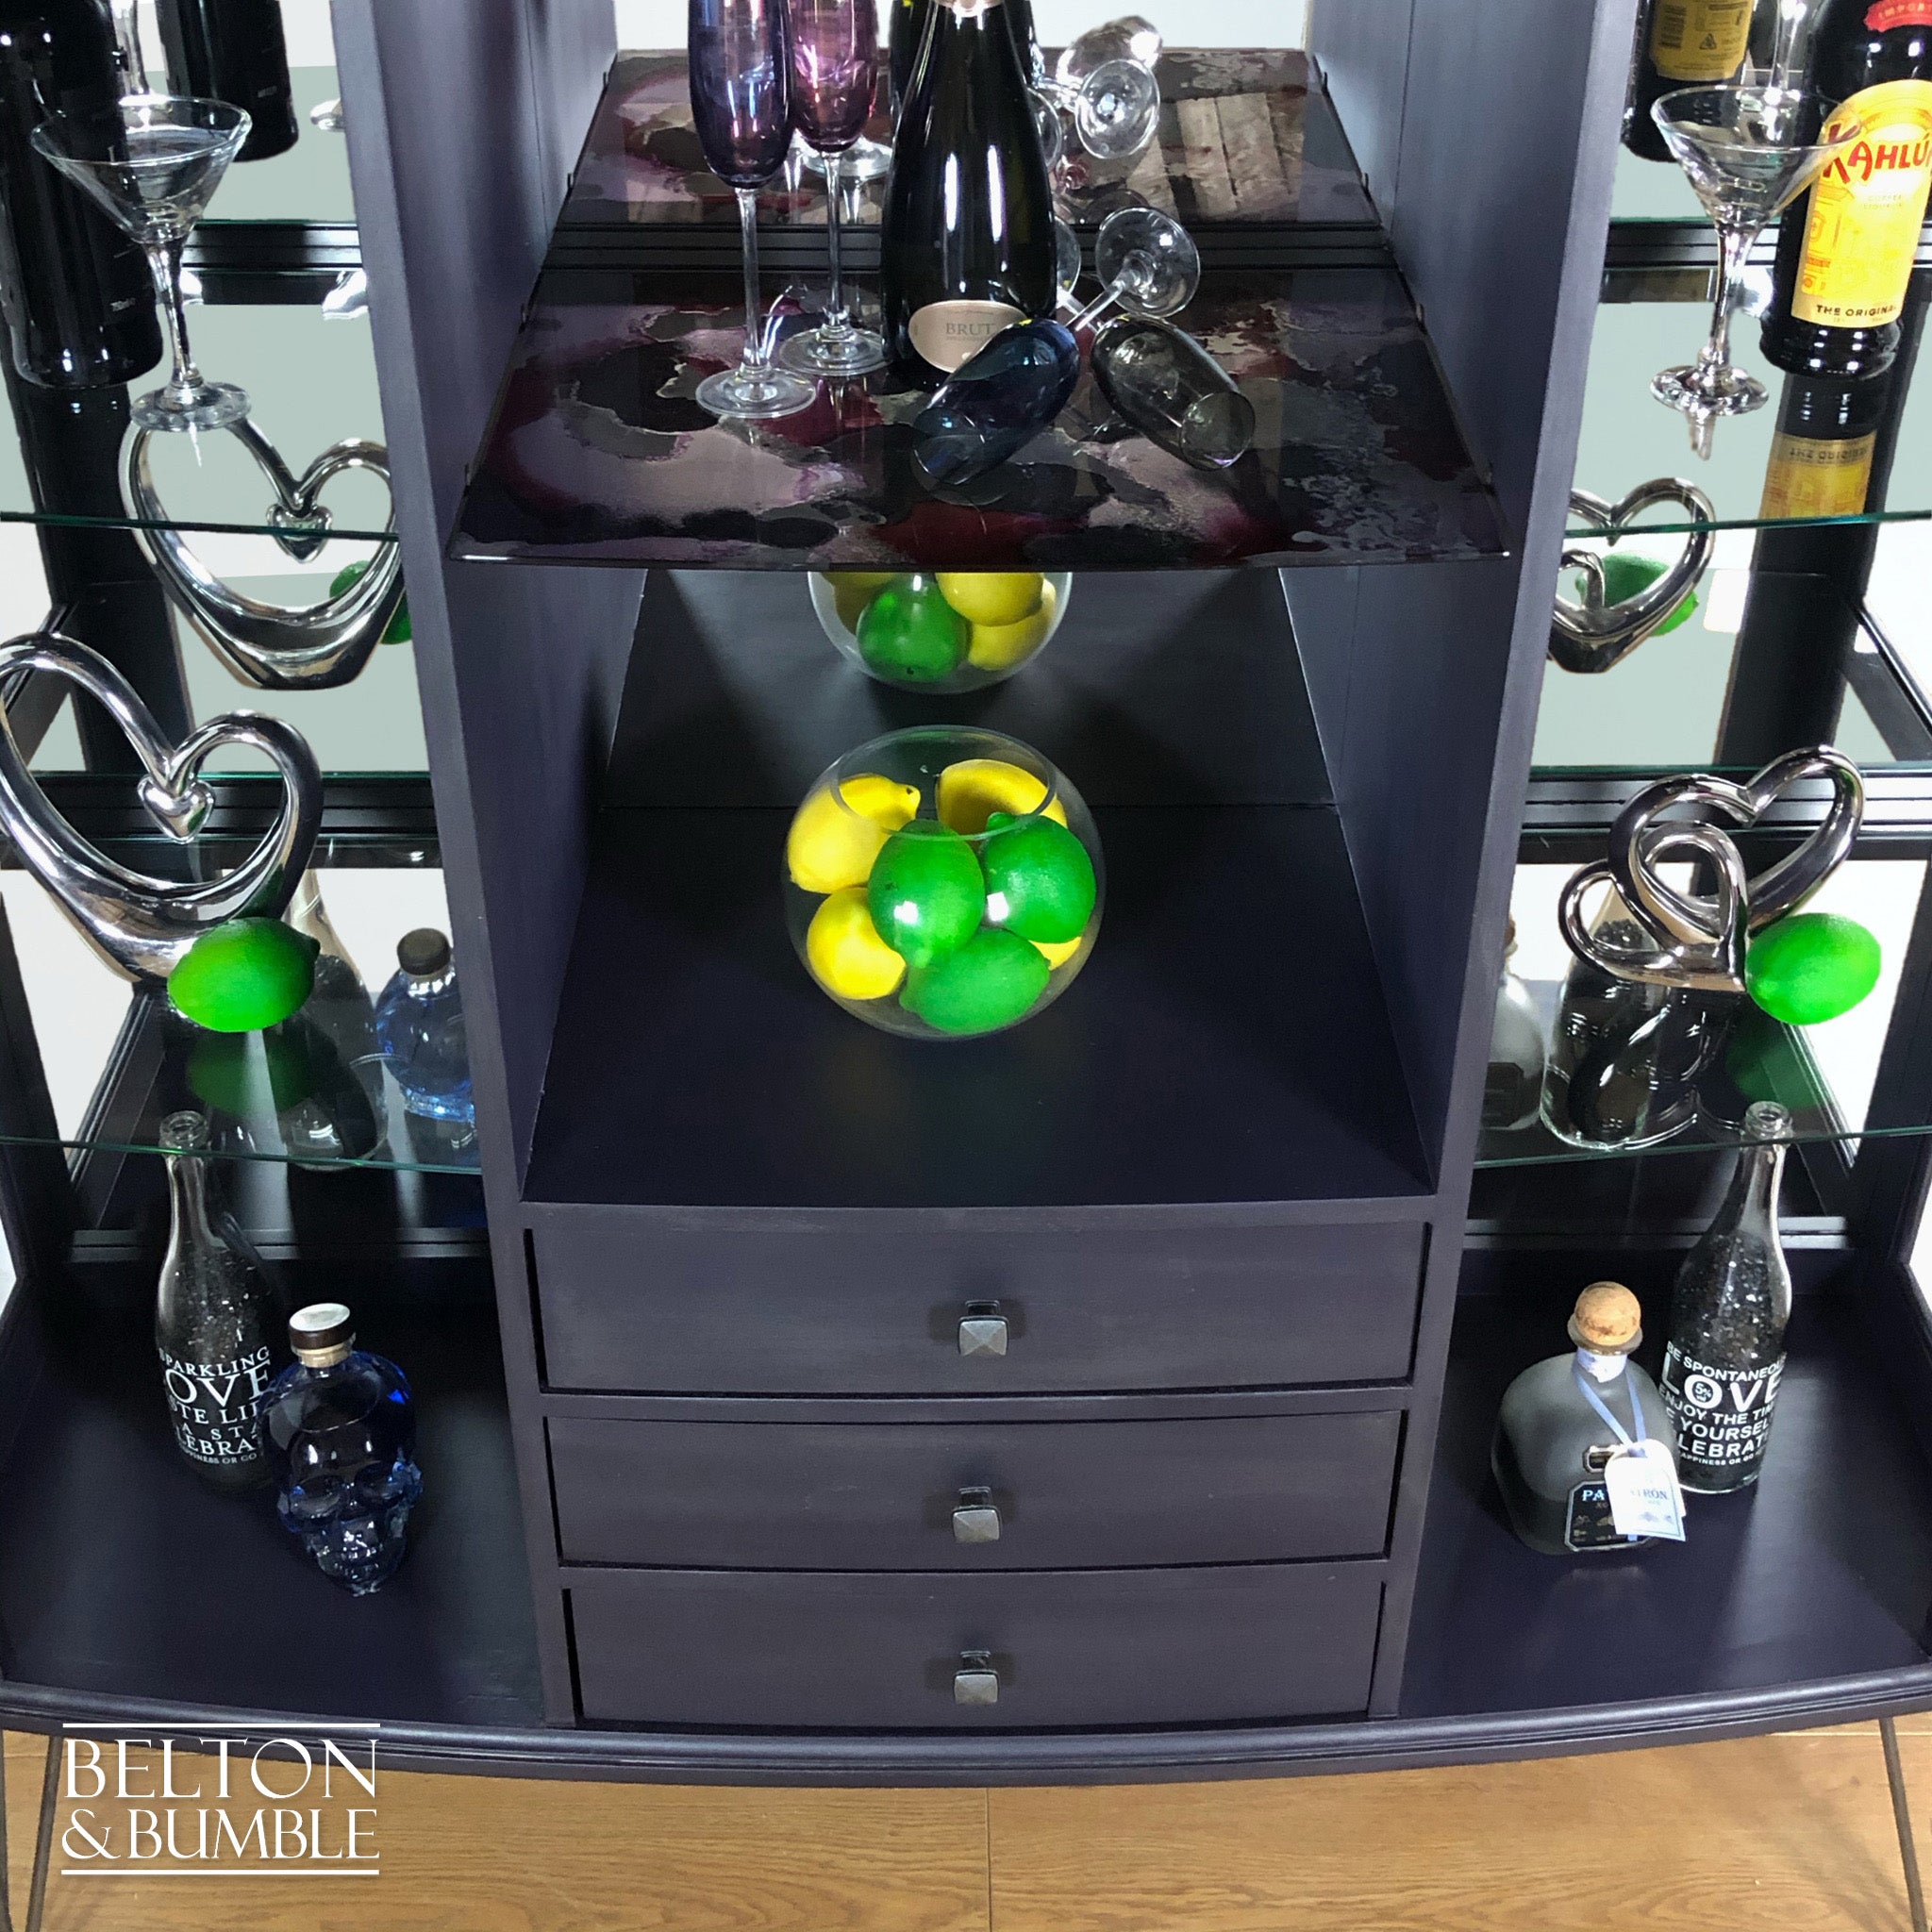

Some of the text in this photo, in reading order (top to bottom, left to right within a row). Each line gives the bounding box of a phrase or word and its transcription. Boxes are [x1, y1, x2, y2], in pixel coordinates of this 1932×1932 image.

[1816, 305, 1896, 317] THE ORIGINA
[946, 323, 994, 335] BRUT
[1666, 1341, 1681, 1361] BE
[165, 1358, 271, 1407] OVE
[1662, 1351, 1783, 1412] LOVE
[1712, 1412, 1749, 1425] THE
[1680, 1416, 1769, 1441] YOURSEL
[222, 1457, 238, 1465] OR
[1680, 1452, 1727, 1465] APPINESS
